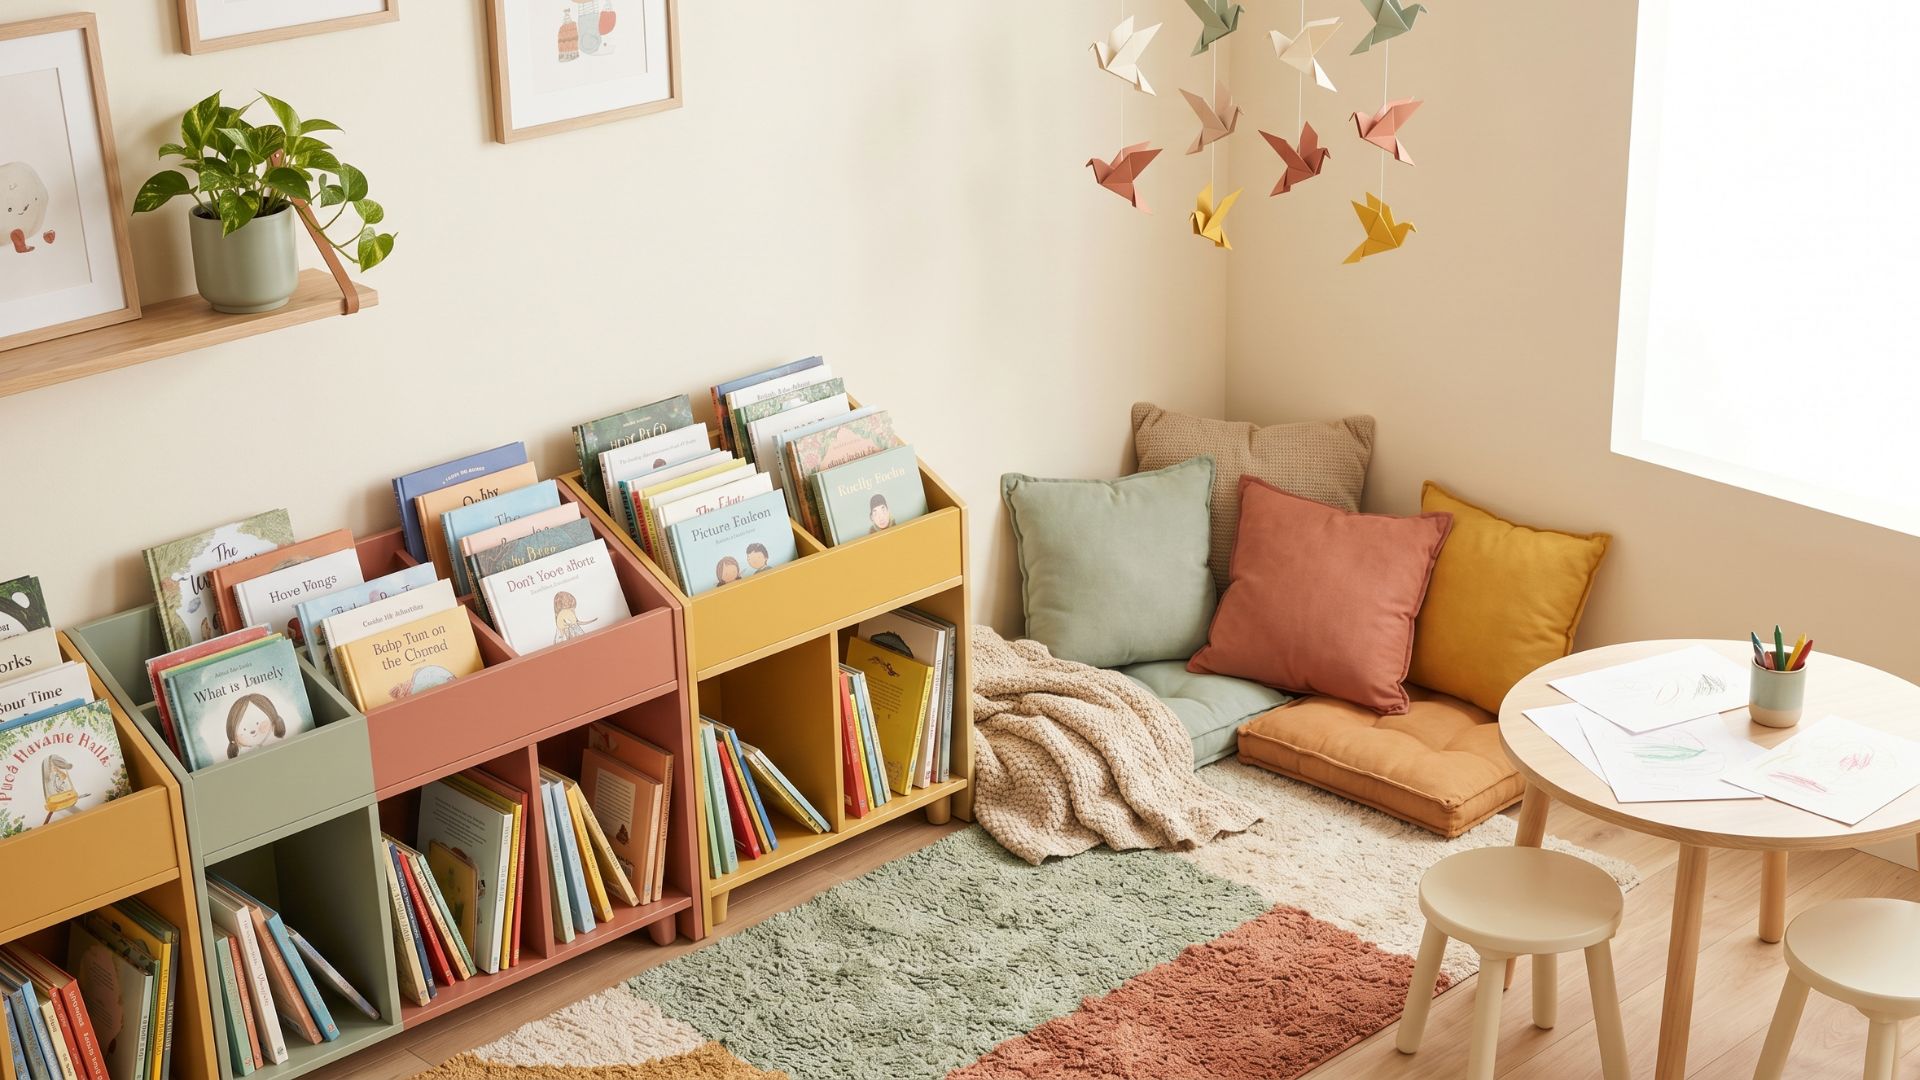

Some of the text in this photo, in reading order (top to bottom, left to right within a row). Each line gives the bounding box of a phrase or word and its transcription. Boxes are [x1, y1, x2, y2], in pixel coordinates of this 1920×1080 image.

[212, 542, 238, 563] The
[506, 574, 535, 592] Don't
[431, 625, 446, 637] on
[382, 654, 402, 671] the
[28, 687, 63, 705] Time
[193, 685, 227, 704] What
[230, 682, 241, 693] is
